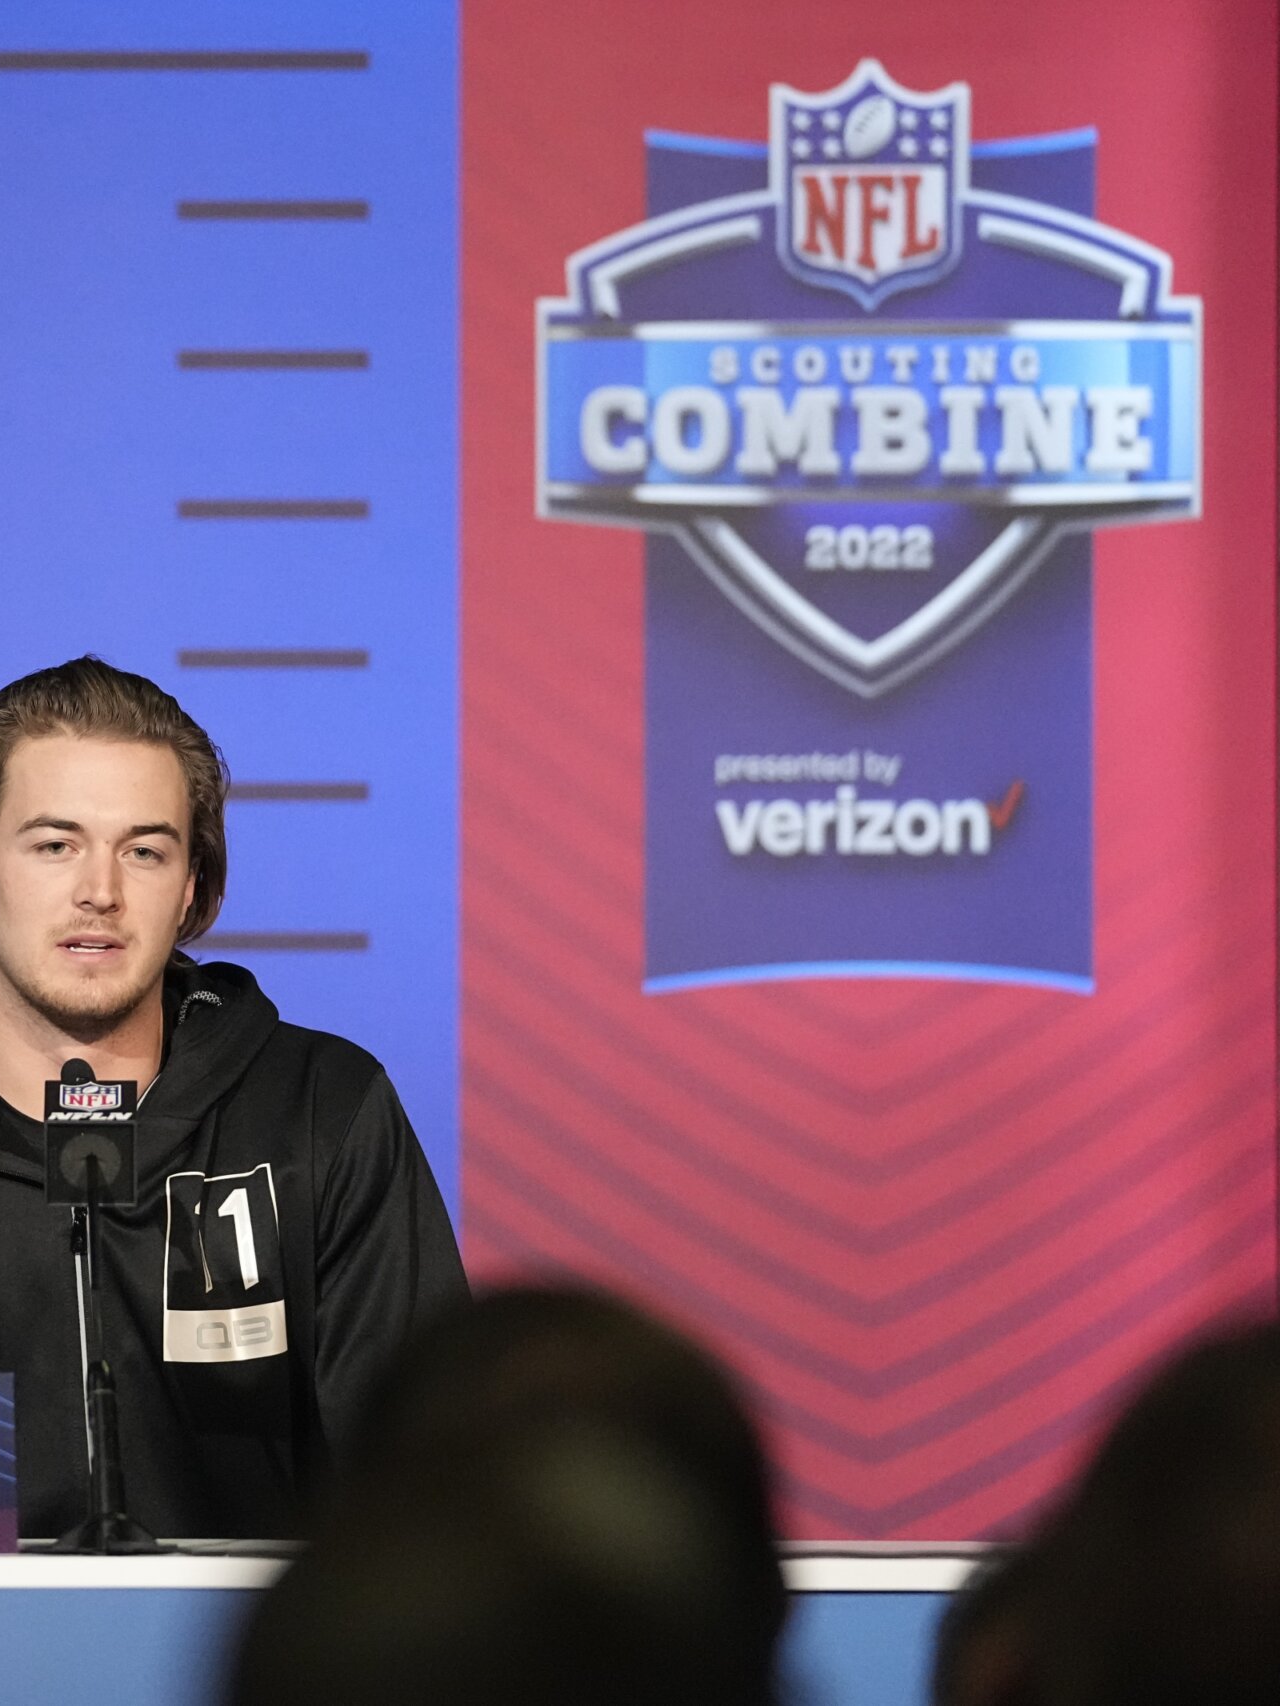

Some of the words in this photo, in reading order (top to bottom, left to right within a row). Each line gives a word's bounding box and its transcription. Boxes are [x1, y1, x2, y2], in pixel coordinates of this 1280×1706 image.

[803, 175, 938, 270] NFL
[709, 348, 1040, 384] SCOUTING
[582, 387, 1152, 476] COMBINE
[804, 525, 934, 571] 2022
[715, 752, 860, 784] presented
[864, 752, 901, 785] by
[716, 784, 991, 857] verizon
[69, 1095, 113, 1106] NFL
